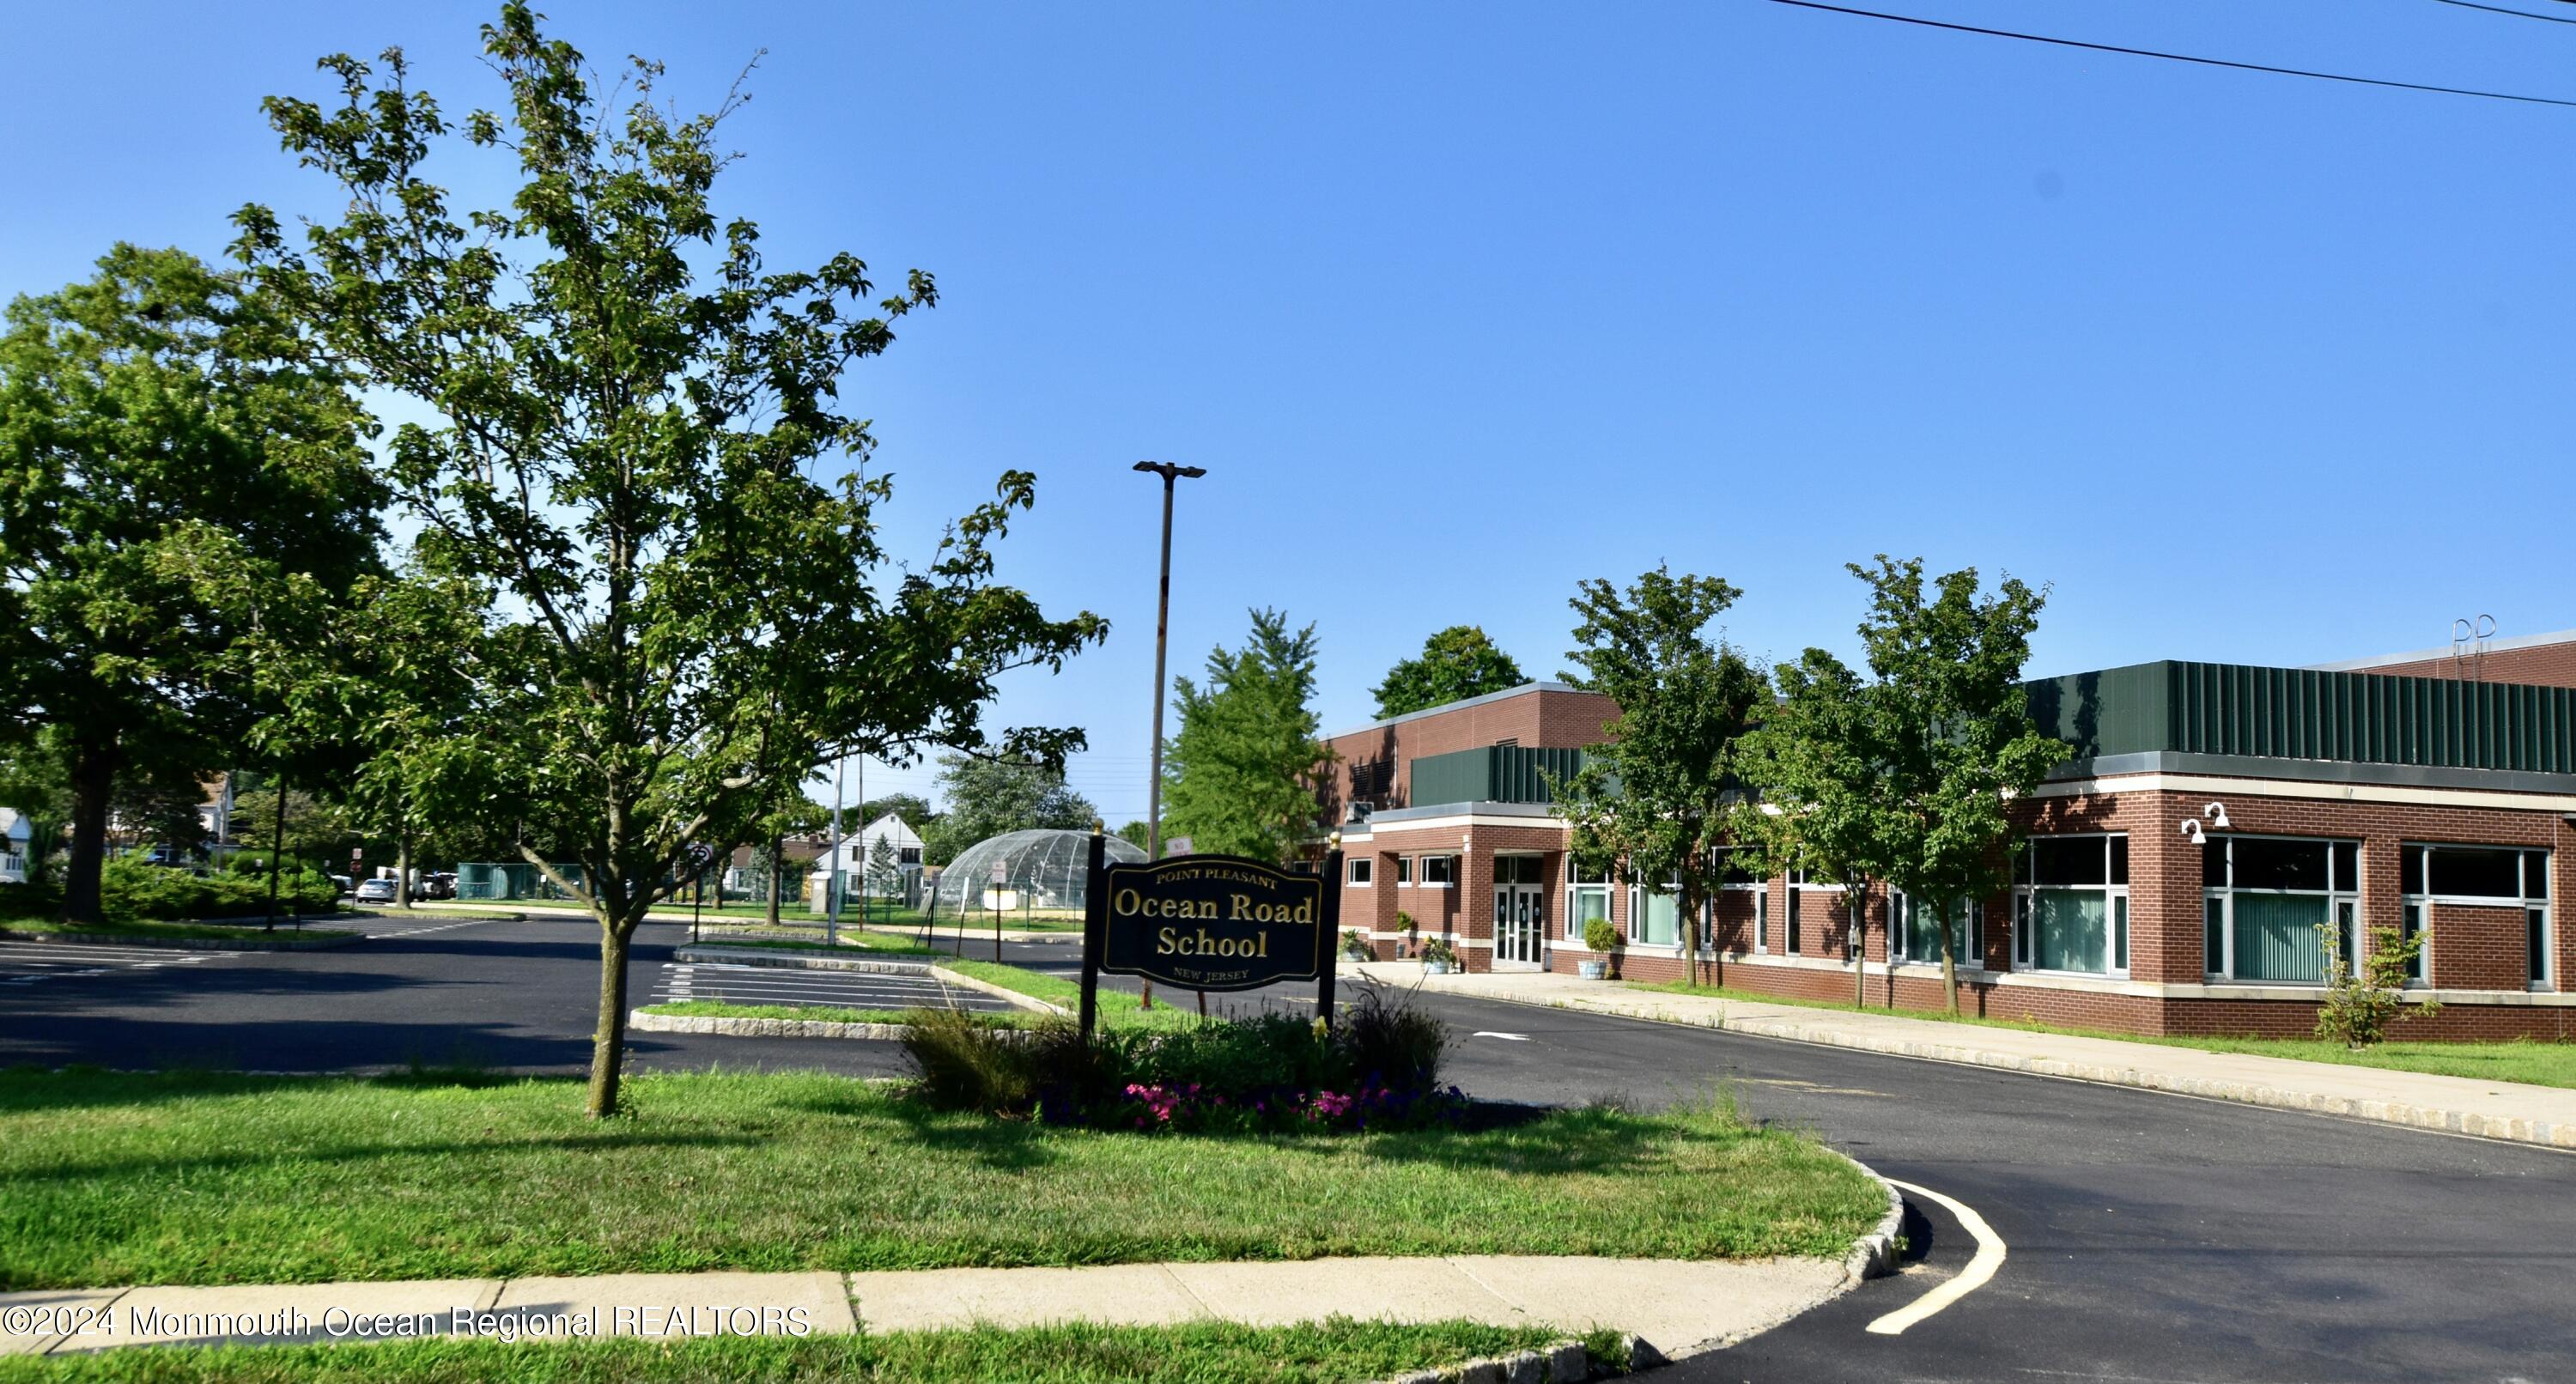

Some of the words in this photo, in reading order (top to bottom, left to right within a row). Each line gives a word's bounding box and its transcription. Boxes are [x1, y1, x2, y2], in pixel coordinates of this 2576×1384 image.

[1156, 869, 1201, 884] POINT
[1205, 869, 1278, 889] PLEASANT
[1115, 889, 1218, 920] Ocean
[1229, 894, 1313, 924] Road
[1157, 926, 1268, 958] School
[1174, 967, 1202, 980] NEW
[1203, 968, 1249, 983] JERSEY
